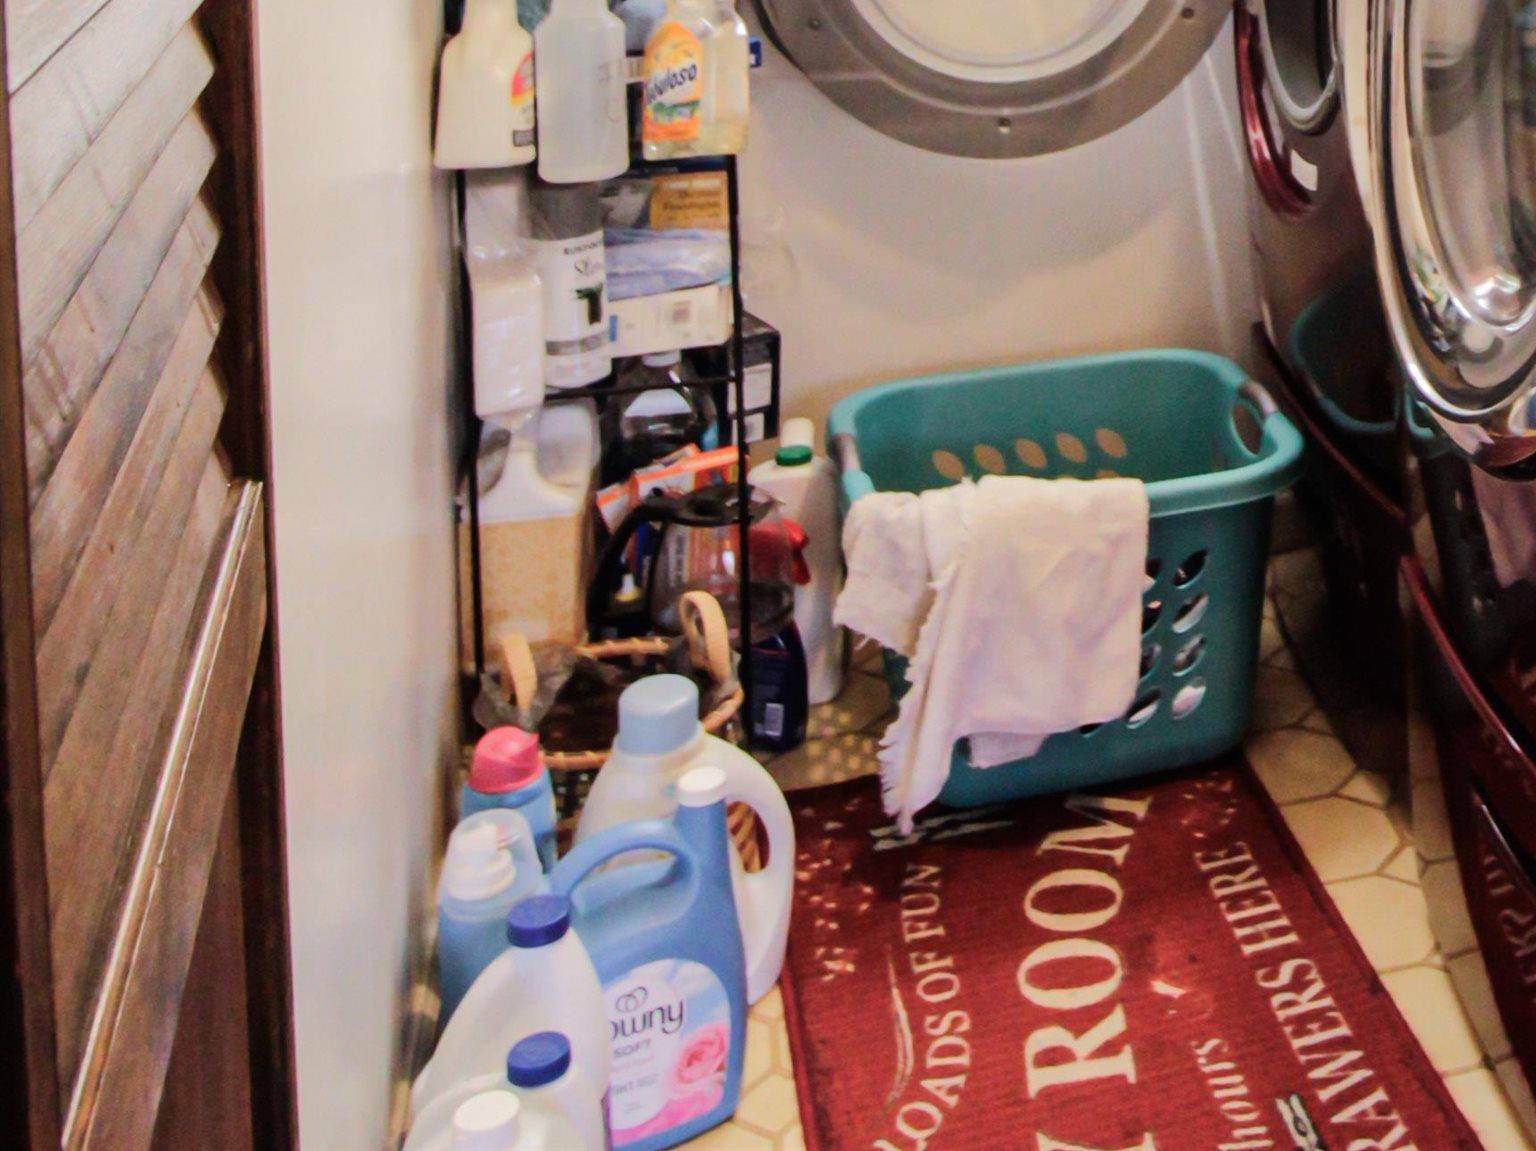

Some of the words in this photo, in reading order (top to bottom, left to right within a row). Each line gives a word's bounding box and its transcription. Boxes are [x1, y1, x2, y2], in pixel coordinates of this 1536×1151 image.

[900, 864, 947, 943] FUN
[1016, 796, 1152, 1099] ROOM
[1194, 841, 1299, 960] HERE
[909, 951, 961, 1003] OF
